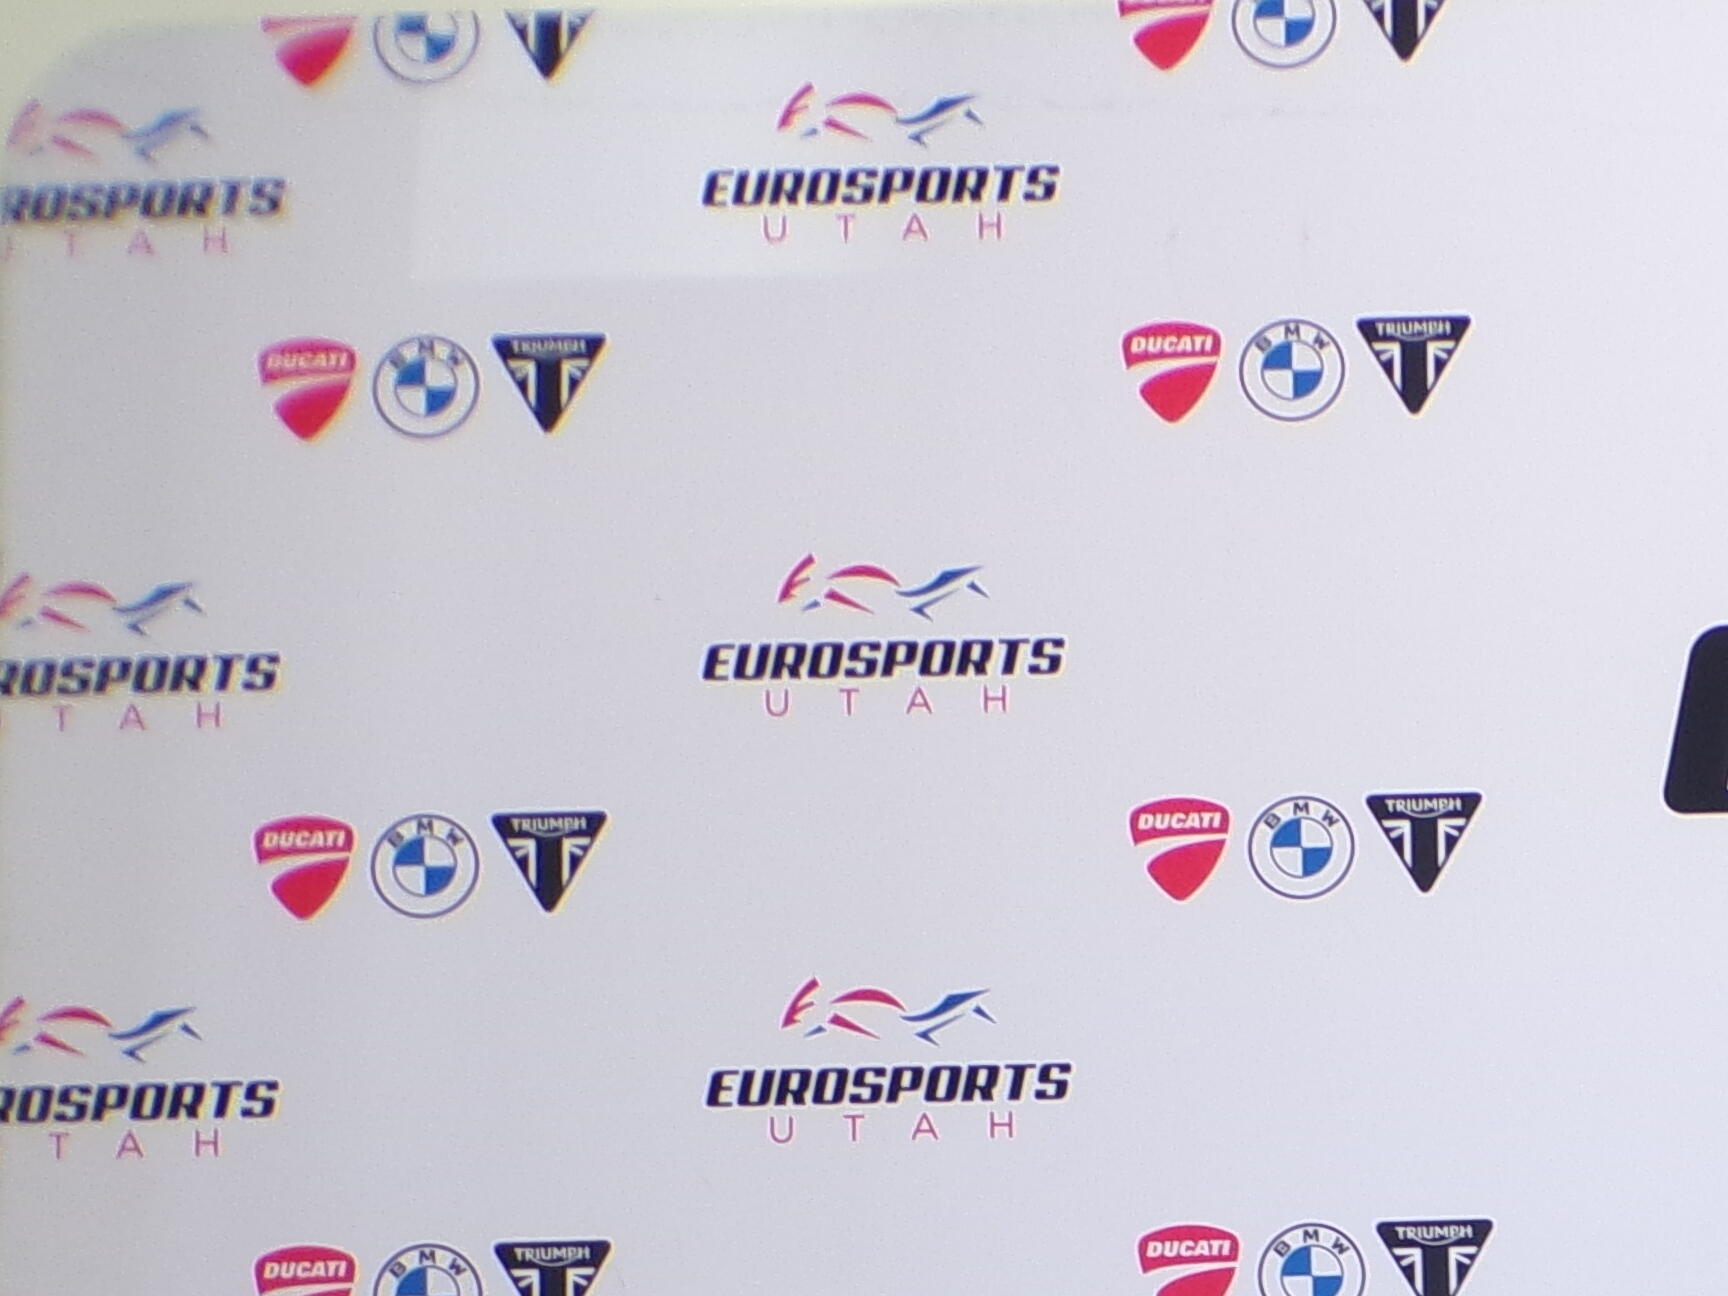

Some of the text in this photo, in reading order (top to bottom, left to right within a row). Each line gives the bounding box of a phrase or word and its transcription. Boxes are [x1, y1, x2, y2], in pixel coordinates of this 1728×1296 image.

[704, 167, 1059, 206] EUROSPORTS
[764, 213, 1005, 244] UTAH
[0, 227, 231, 260] TAH
[1376, 320, 1451, 338] TRIUMPH
[1130, 335, 1213, 354] DUCATI
[703, 639, 1064, 680] EUROSPORTS
[764, 687, 1009, 717] UTAH
[55, 704, 224, 731] TAH
[1264, 802, 1340, 829] BMW
[1385, 797, 1462, 814] TRIUMPH
[510, 816, 588, 833] TRIUMPH
[1139, 811, 1221, 831] DUCATI
[261, 829, 346, 850] DUCATI
[707, 1064, 1071, 1107] EUROSPORTS
[768, 1112, 1016, 1144] UTAH
[52, 1132, 222, 1160] TAH
[1274, 1229, 1351, 1259] BMW
[1395, 1224, 1473, 1242] TRIUMPH
[514, 1245, 591, 1262] TRIUMPH
[1146, 1239, 1231, 1259] DUCATI
[263, 1260, 347, 1281] DUCATI
[388, 1249, 468, 1280] BMW
